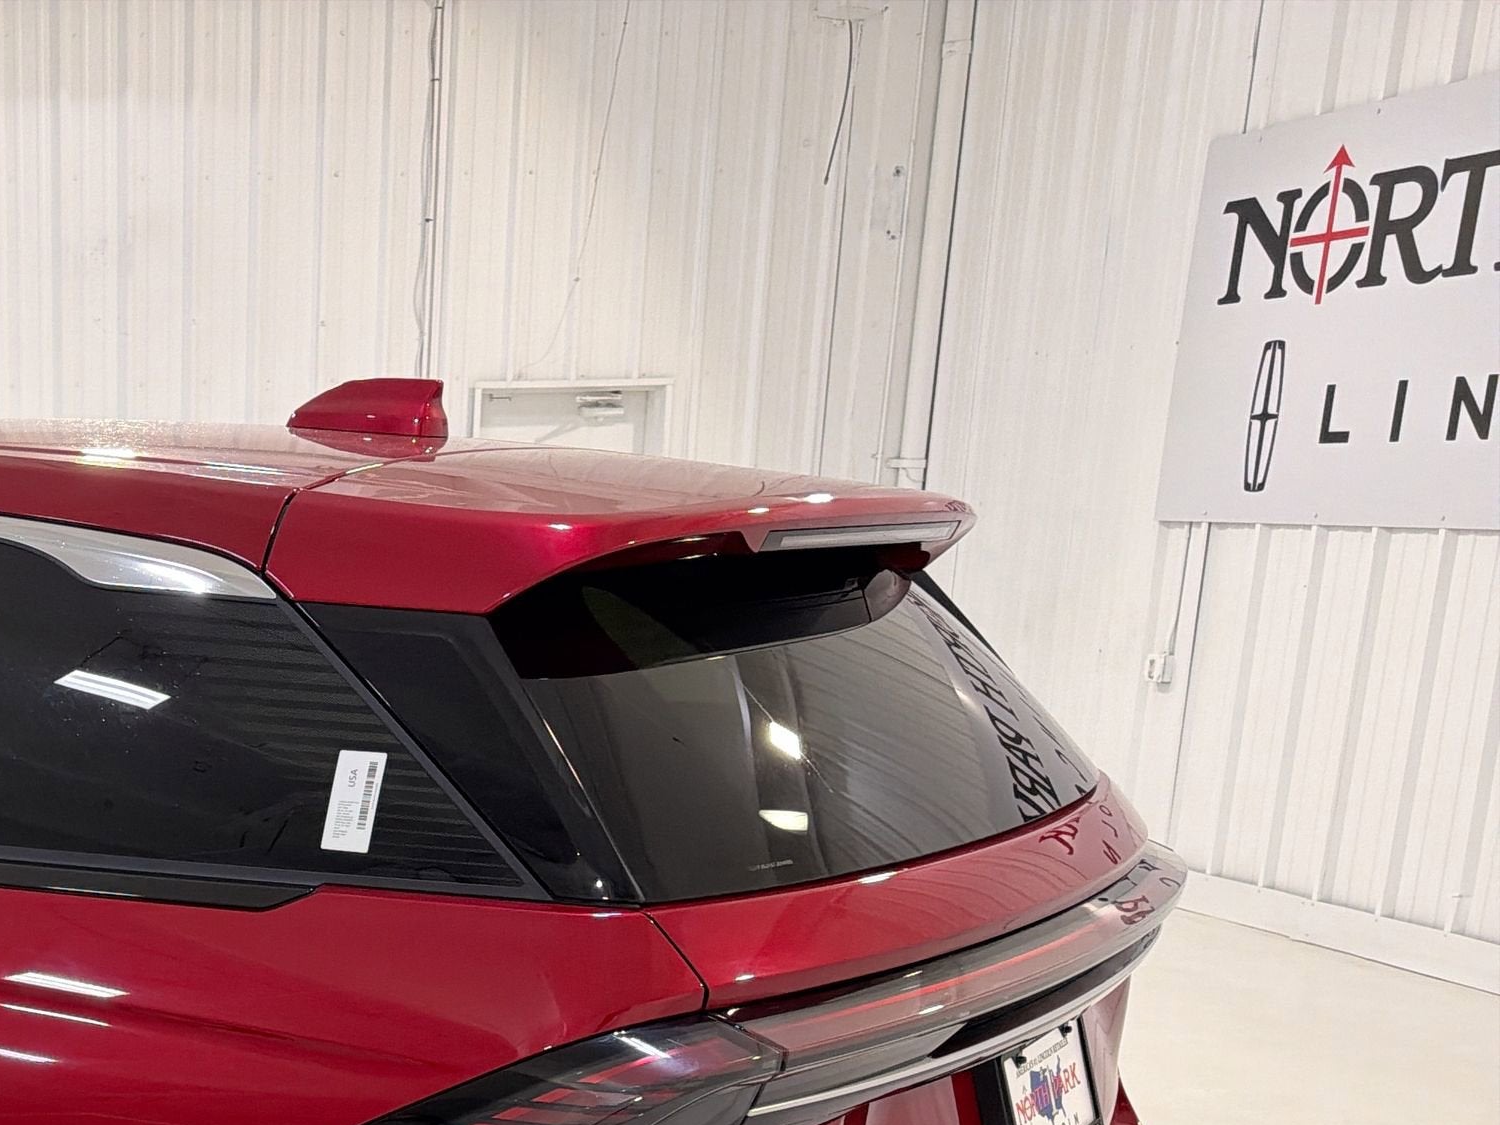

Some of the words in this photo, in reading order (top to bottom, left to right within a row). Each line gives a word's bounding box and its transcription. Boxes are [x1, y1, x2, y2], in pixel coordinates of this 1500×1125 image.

[1217, 149, 1500, 305] NORT
[348, 769, 358, 788] USA
[1053, 1062, 1081, 1099] PARK
